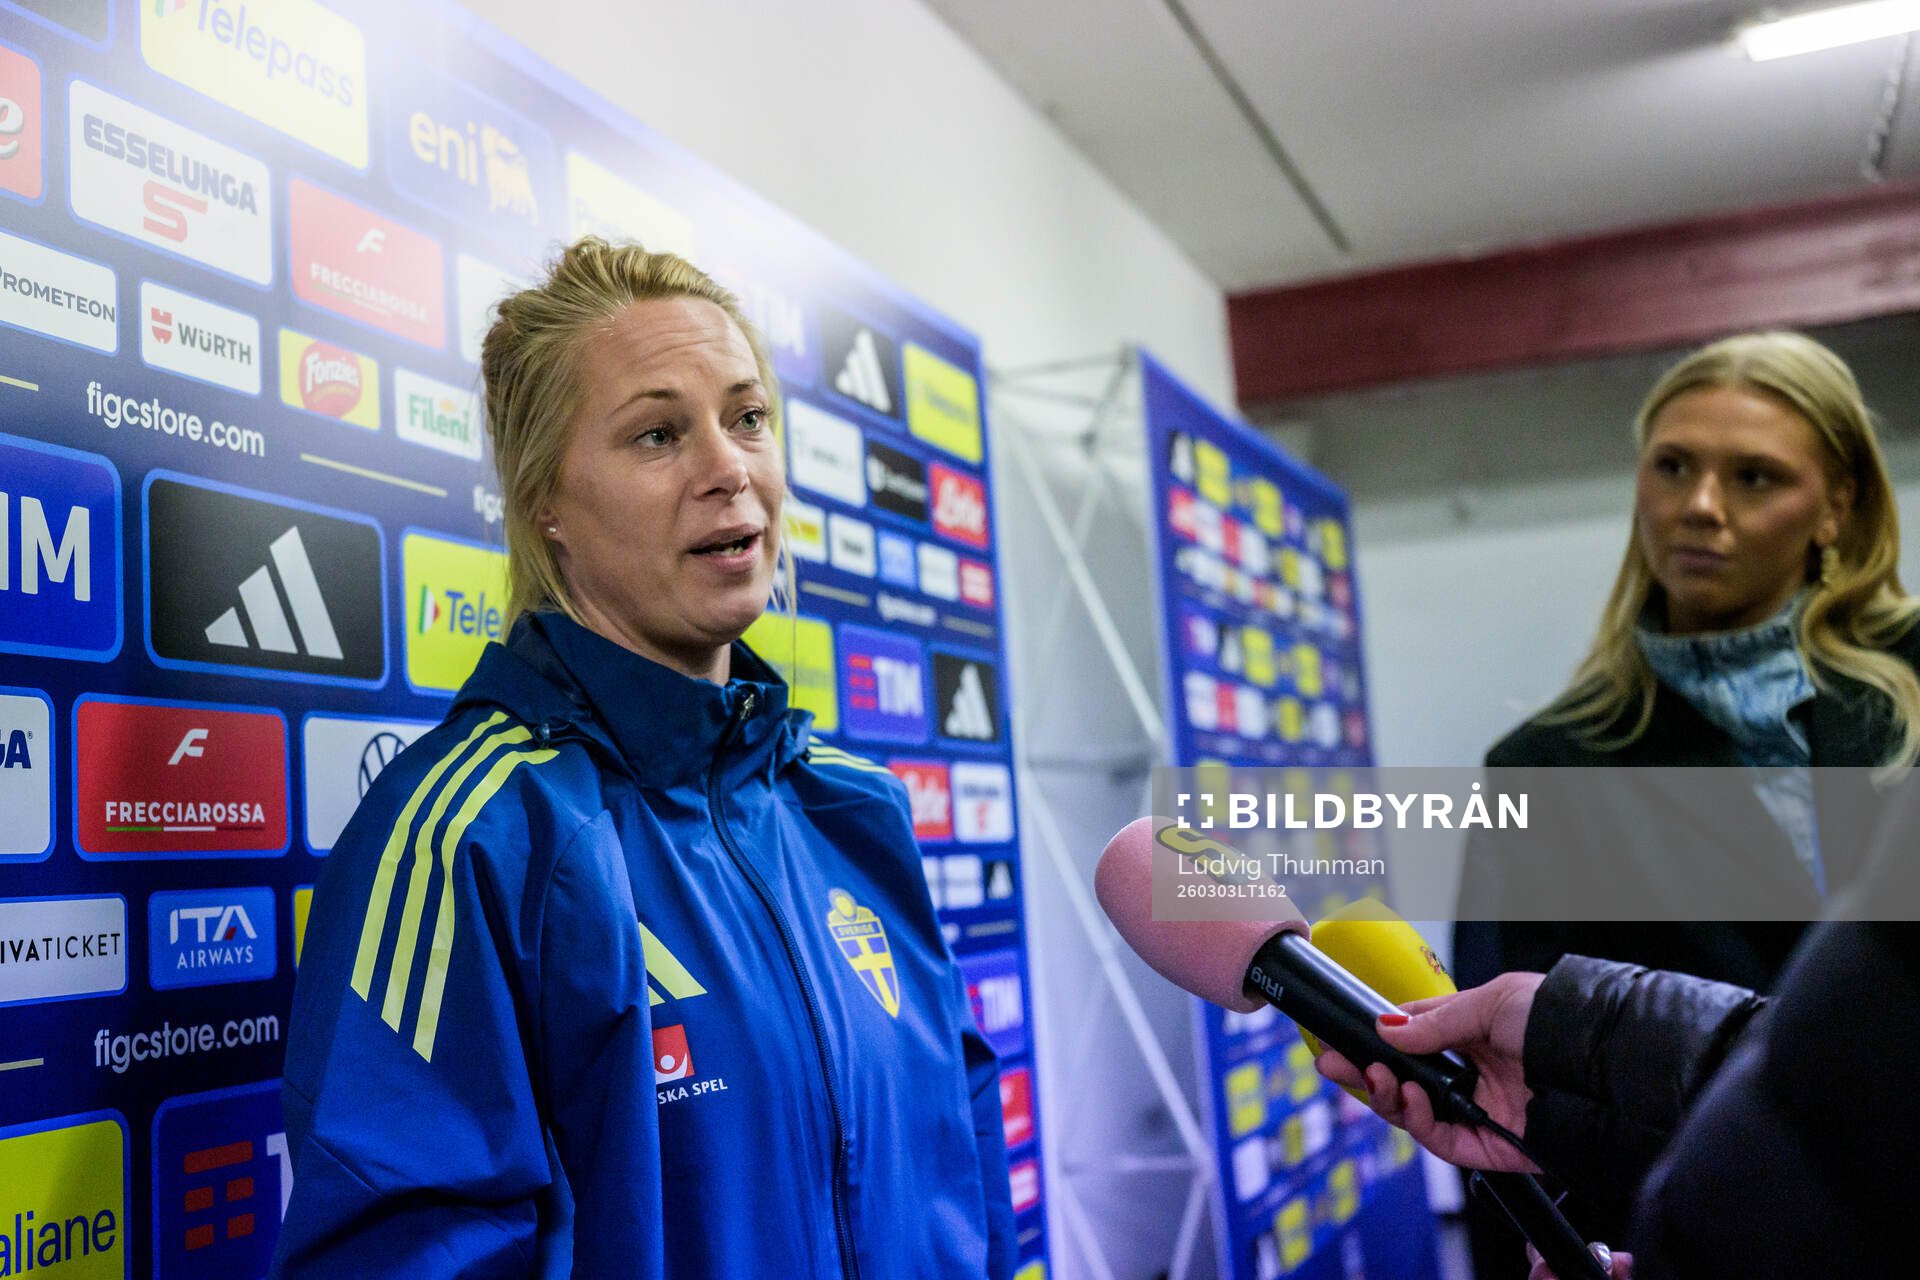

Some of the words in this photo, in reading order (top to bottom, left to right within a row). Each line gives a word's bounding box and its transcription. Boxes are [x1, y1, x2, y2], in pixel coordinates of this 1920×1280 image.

[83, 113, 257, 216] ESSELUNGA
[410, 112, 478, 187] eni
[0, 265, 116, 323] ROMETEON
[309, 262, 430, 322] FRECCIAROSSA
[87, 381, 265, 457] figcstore.com
[408, 393, 469, 444] Fileni
[446, 589, 506, 639] Tele
[106, 801, 265, 823] FRECCIAROSSA
[170, 905, 258, 945] ITA
[177, 945, 254, 970] AIRWAYS
[1250, 966, 1284, 1001] iRig
[94, 1014, 280, 1074] figcstore.com
[692, 1078, 728, 1094] SPEL
